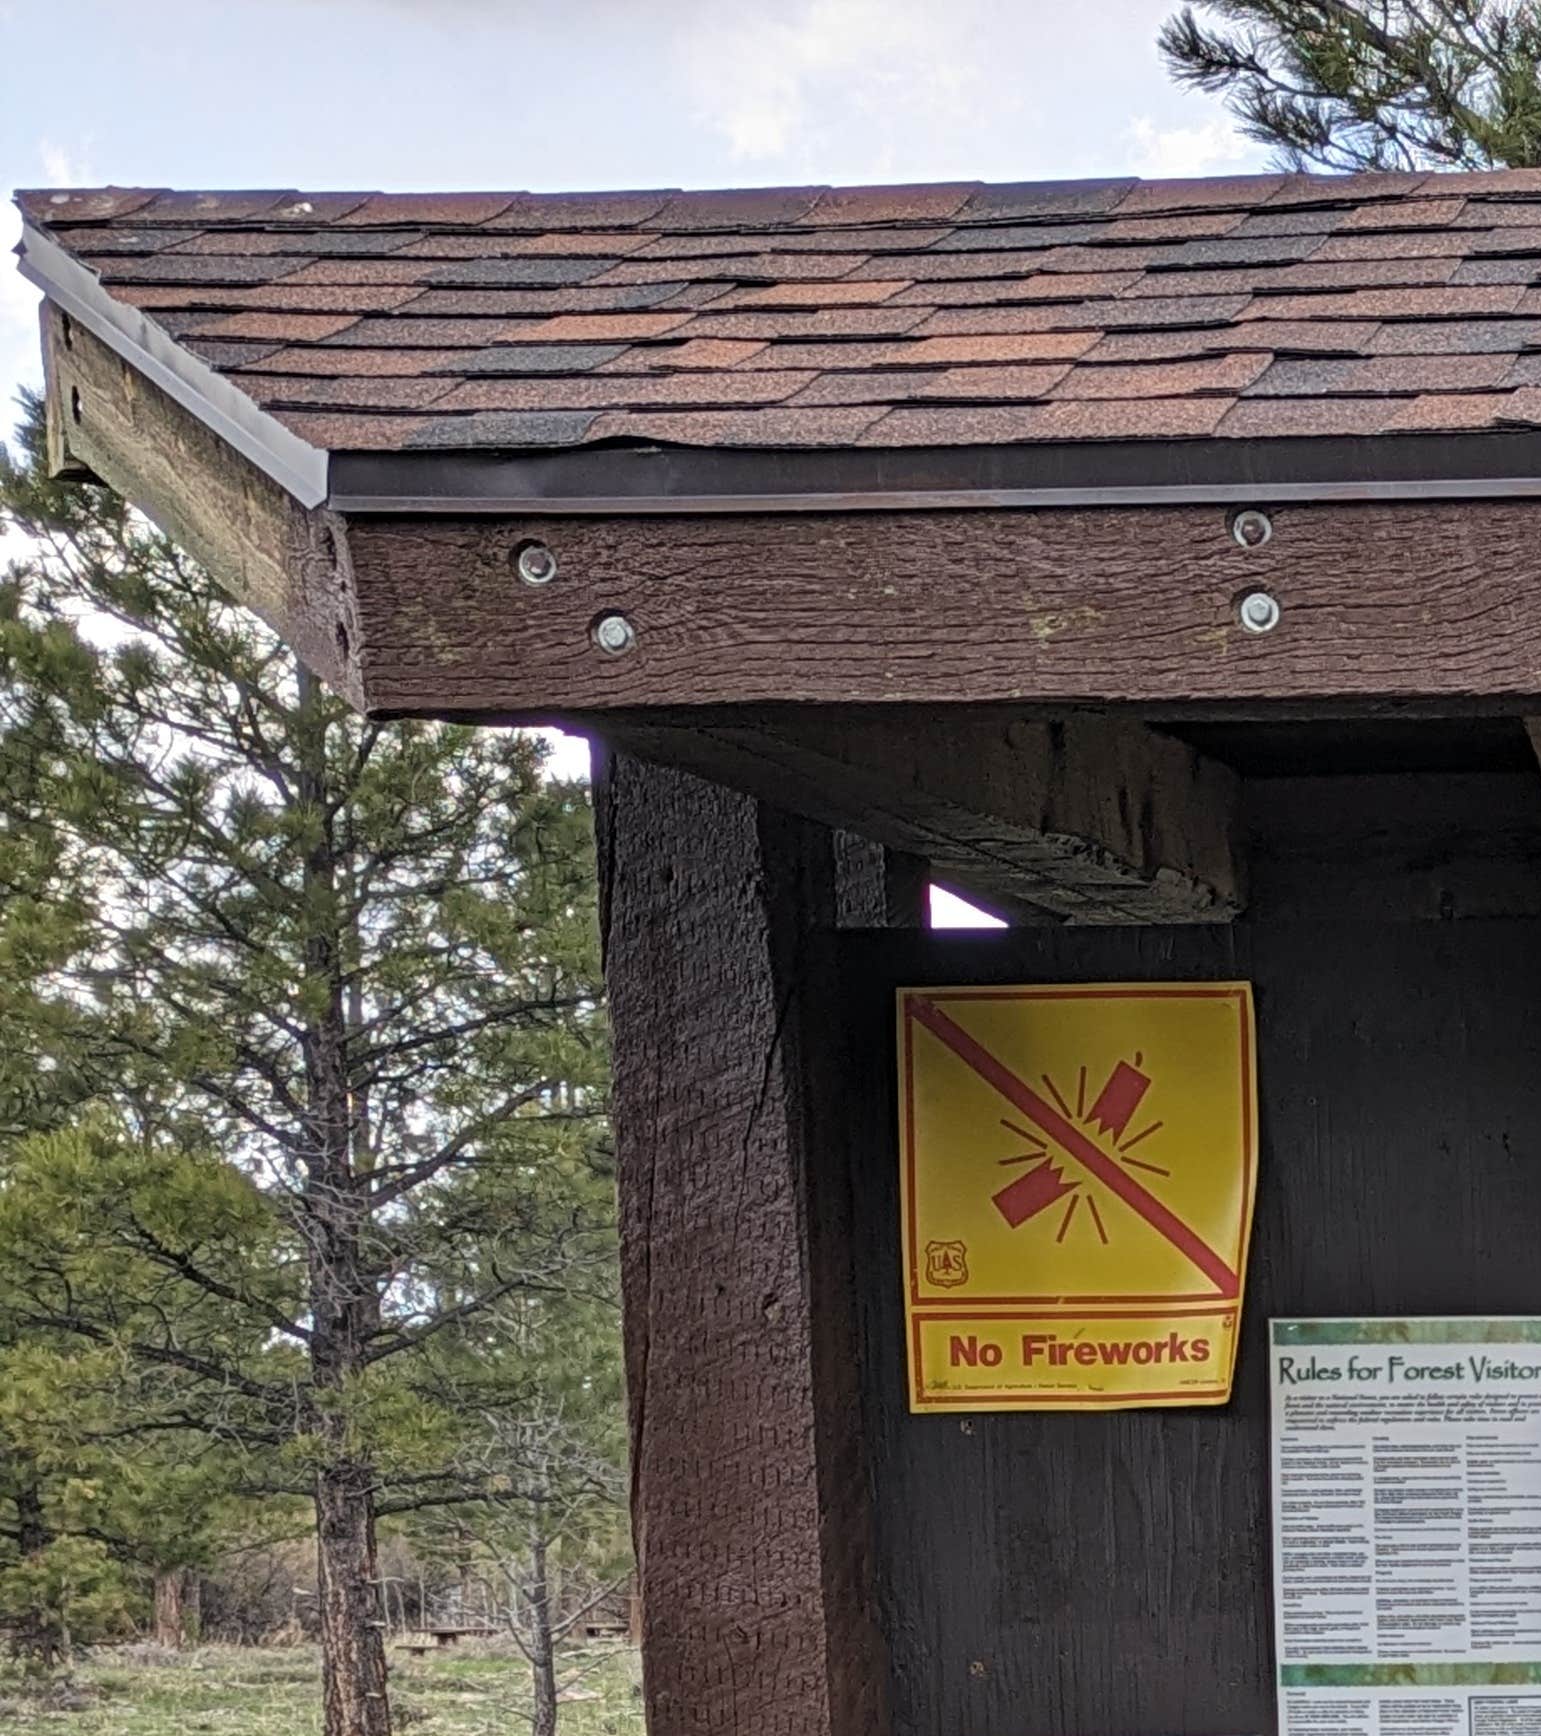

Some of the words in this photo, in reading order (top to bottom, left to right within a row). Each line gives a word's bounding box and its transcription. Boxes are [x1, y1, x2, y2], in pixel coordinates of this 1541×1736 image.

[950, 1335, 1003, 1367] No
[1022, 1332, 1210, 1367] Fireworks
[1279, 1356, 1342, 1385] Rules
[1347, 1355, 1383, 1382] for
[1388, 1356, 1466, 1383] Forest
